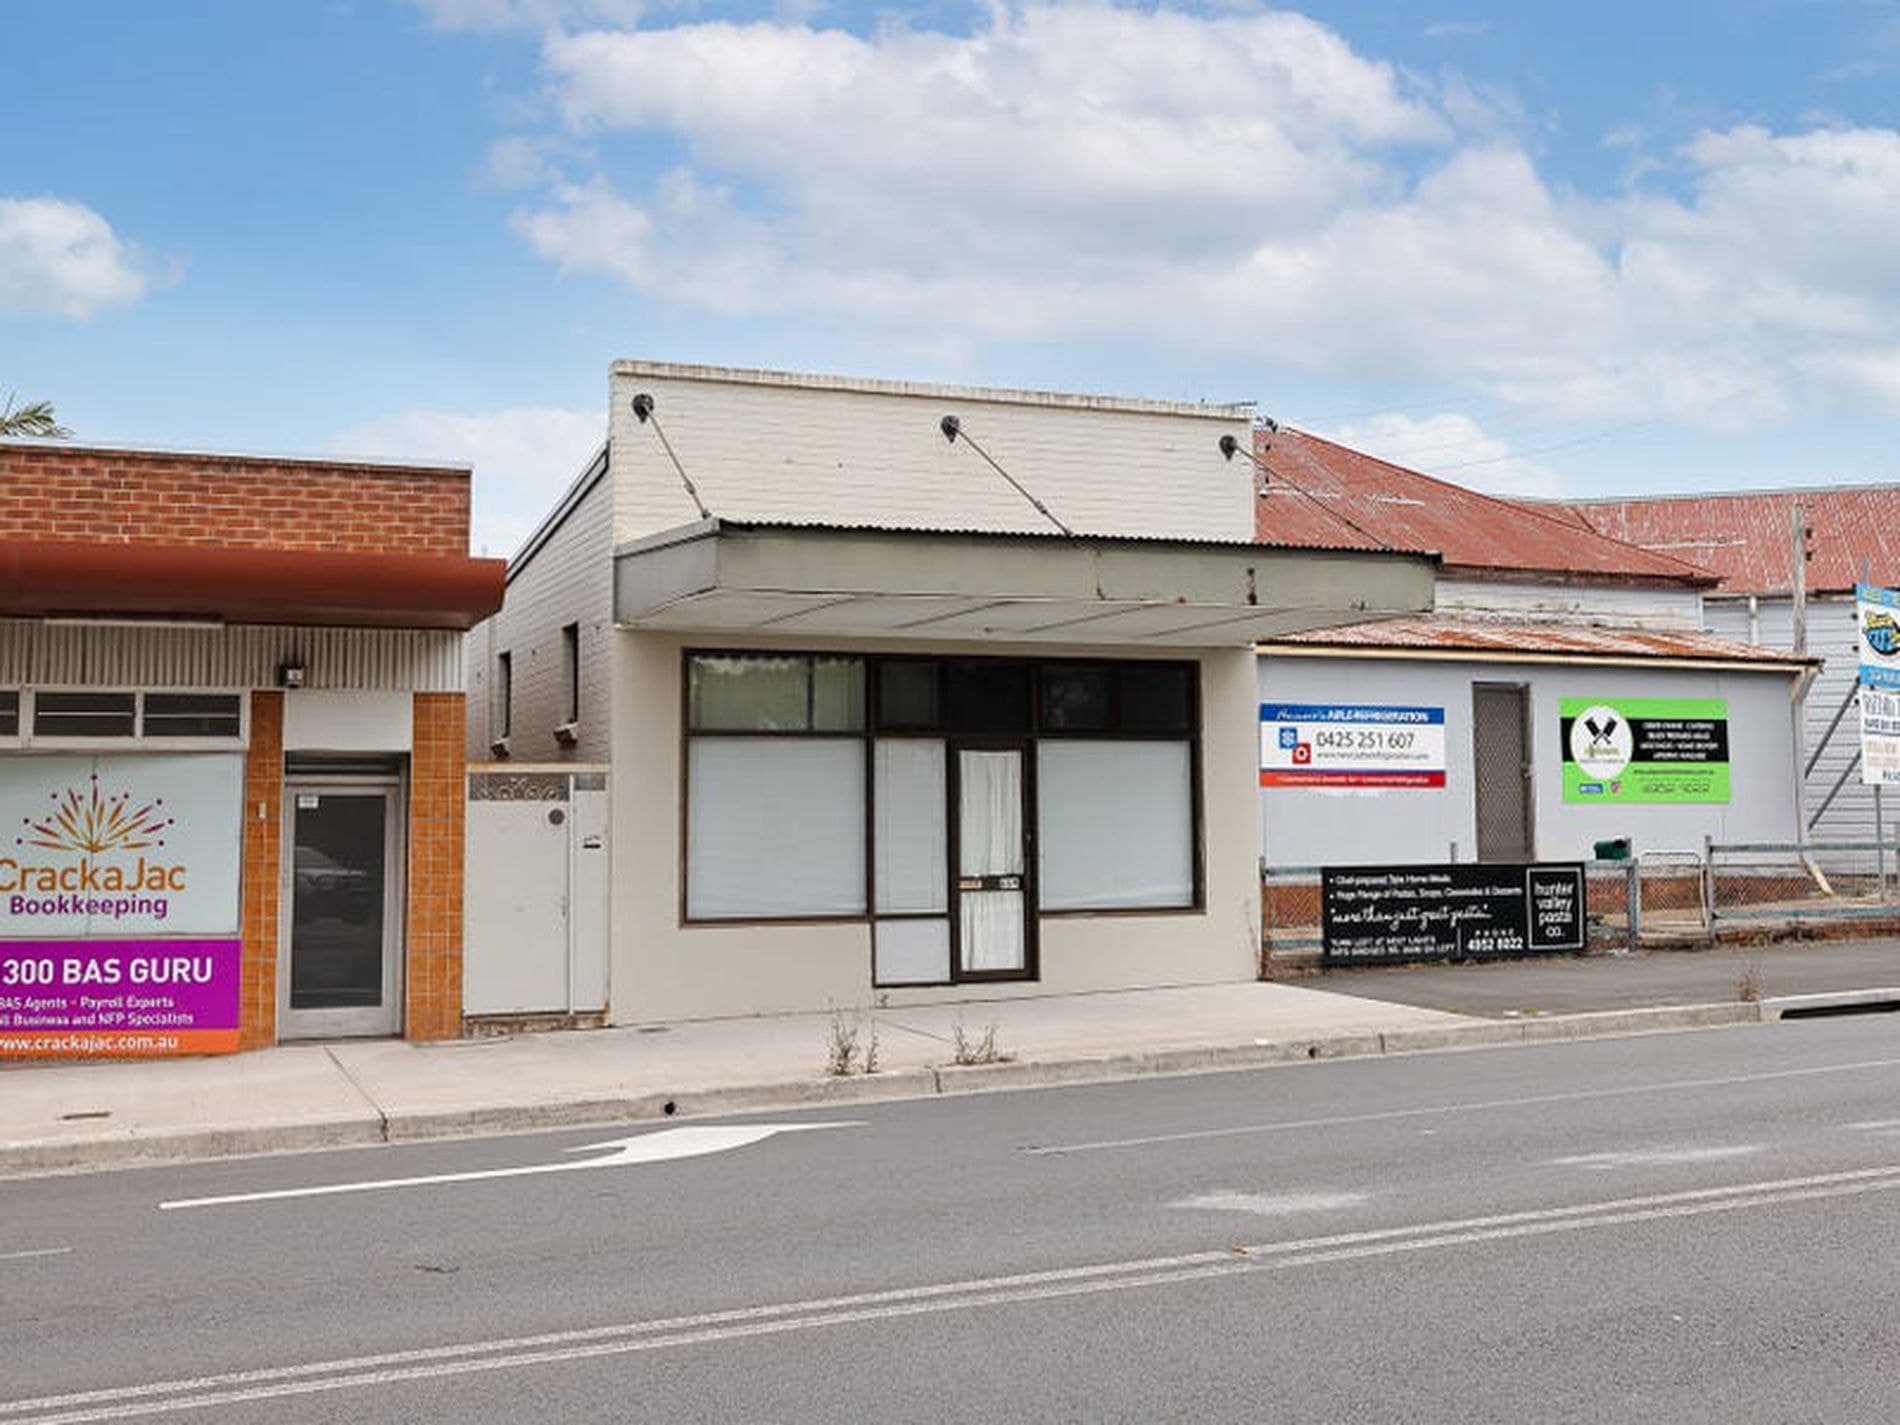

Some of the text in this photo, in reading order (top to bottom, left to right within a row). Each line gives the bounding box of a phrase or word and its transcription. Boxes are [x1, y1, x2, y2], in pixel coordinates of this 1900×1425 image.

[1316, 730, 1415, 750] 0425 251 607
[0, 857, 187, 892] CrackaJac
[1534, 881, 1574, 897] hunter
[9, 893, 168, 920] Bookkeeping
[1536, 896, 1573, 911] valley
[1538, 911, 1573, 927] pasta
[62, 958, 121, 984] BAS
[129, 957, 213, 983] GURU
[0, 995, 175, 1012] BAS Agents Payroll Experts
[13, 1013, 70, 1027] Business
[72, 1012, 96, 1025] and
[99, 1013, 125, 1025] NFP
[128, 1011, 194, 1027] Specialists
[0, 1034, 178, 1053] ww.crackajac.com.au
